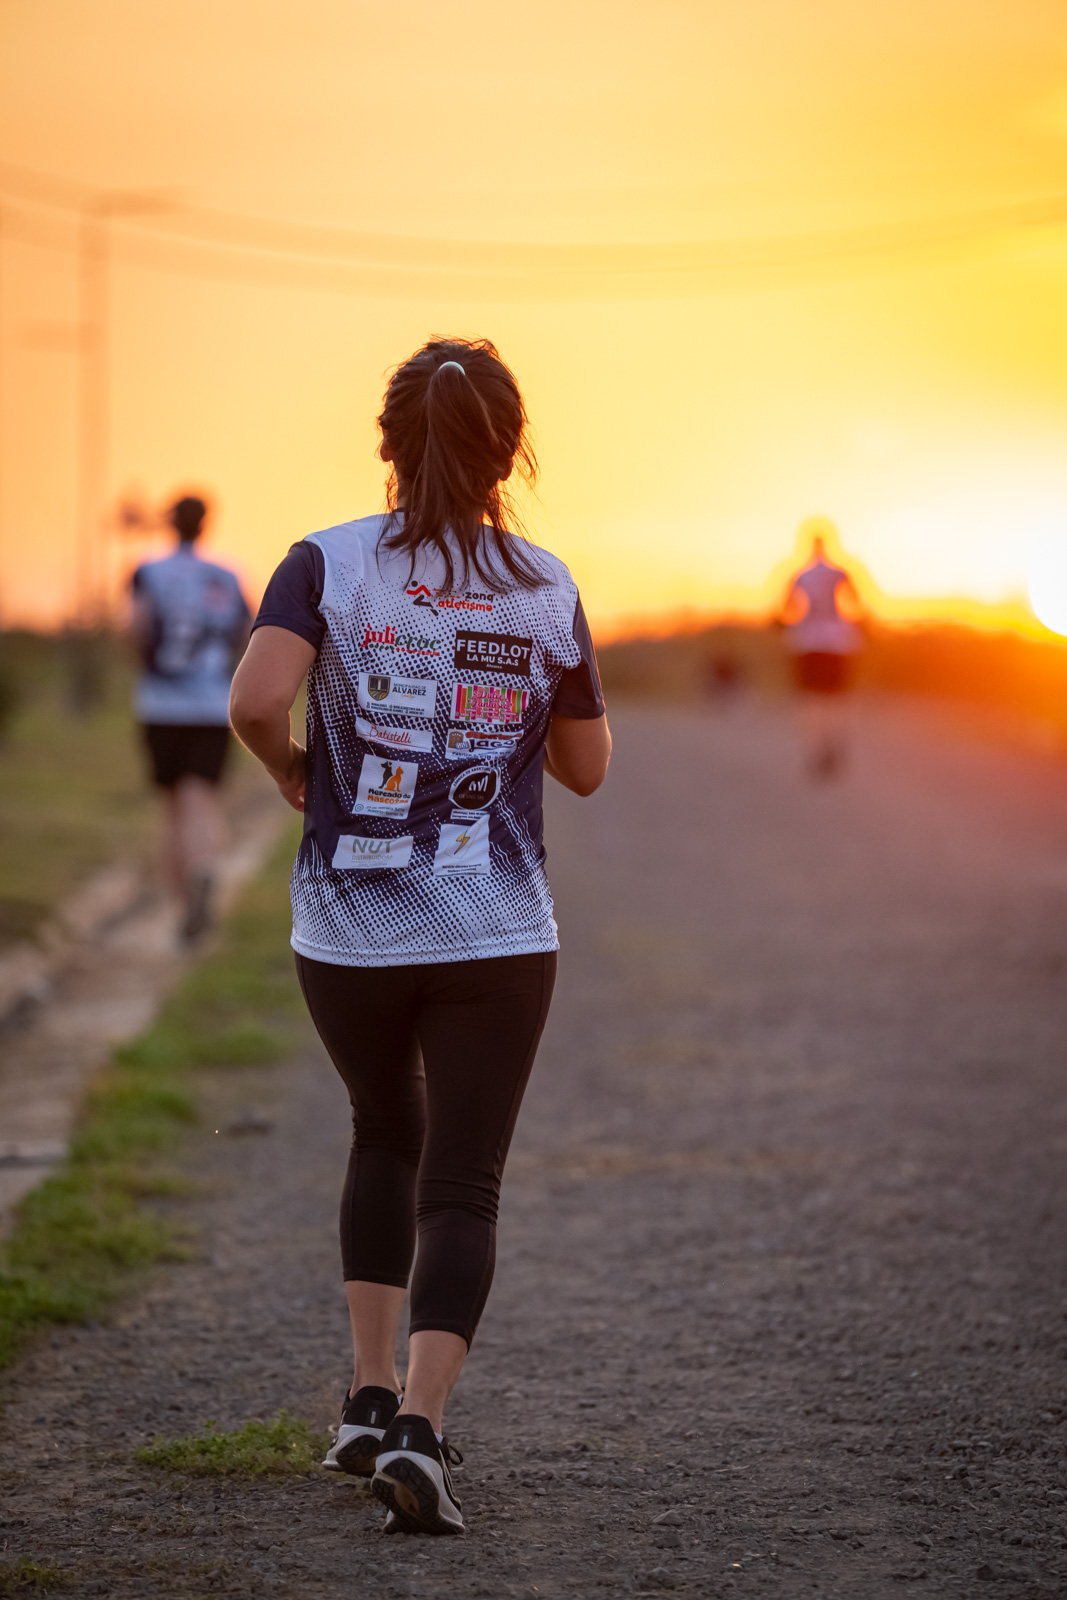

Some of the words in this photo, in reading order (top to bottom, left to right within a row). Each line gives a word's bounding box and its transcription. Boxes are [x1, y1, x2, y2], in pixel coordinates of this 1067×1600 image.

[465, 591, 494, 601] zona
[438, 598, 493, 612] atletismo
[456, 639, 531, 659] FEEDLOT
[467, 653, 479, 662] LA
[481, 655, 496, 664] MU
[497, 656, 519, 667] S.A.S
[392, 686, 427, 696] ALVAREZ
[368, 788, 402, 799] Mercado
[367, 795, 409, 805] Mascotas
